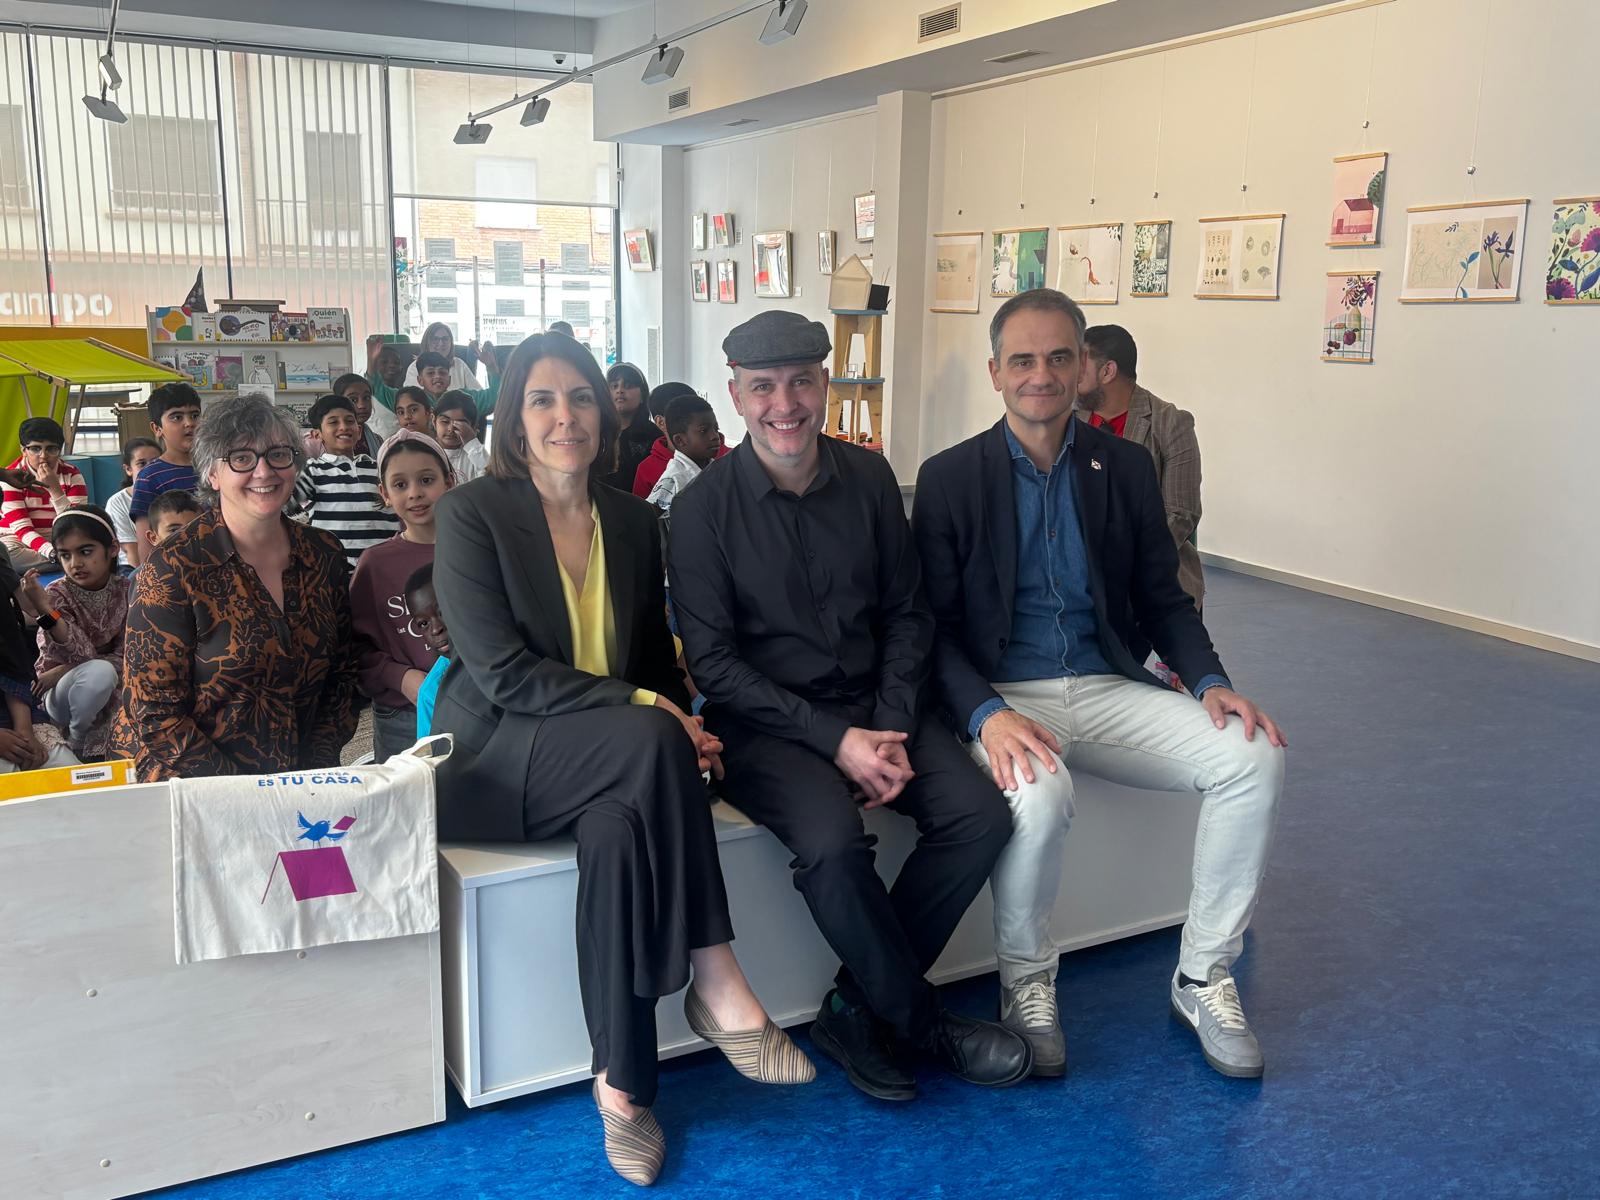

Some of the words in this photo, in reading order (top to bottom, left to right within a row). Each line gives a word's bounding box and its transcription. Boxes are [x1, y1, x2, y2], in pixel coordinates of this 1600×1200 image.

[258, 779, 274, 787] ES
[278, 776, 304, 786] TU
[311, 775, 363, 785] CASA
